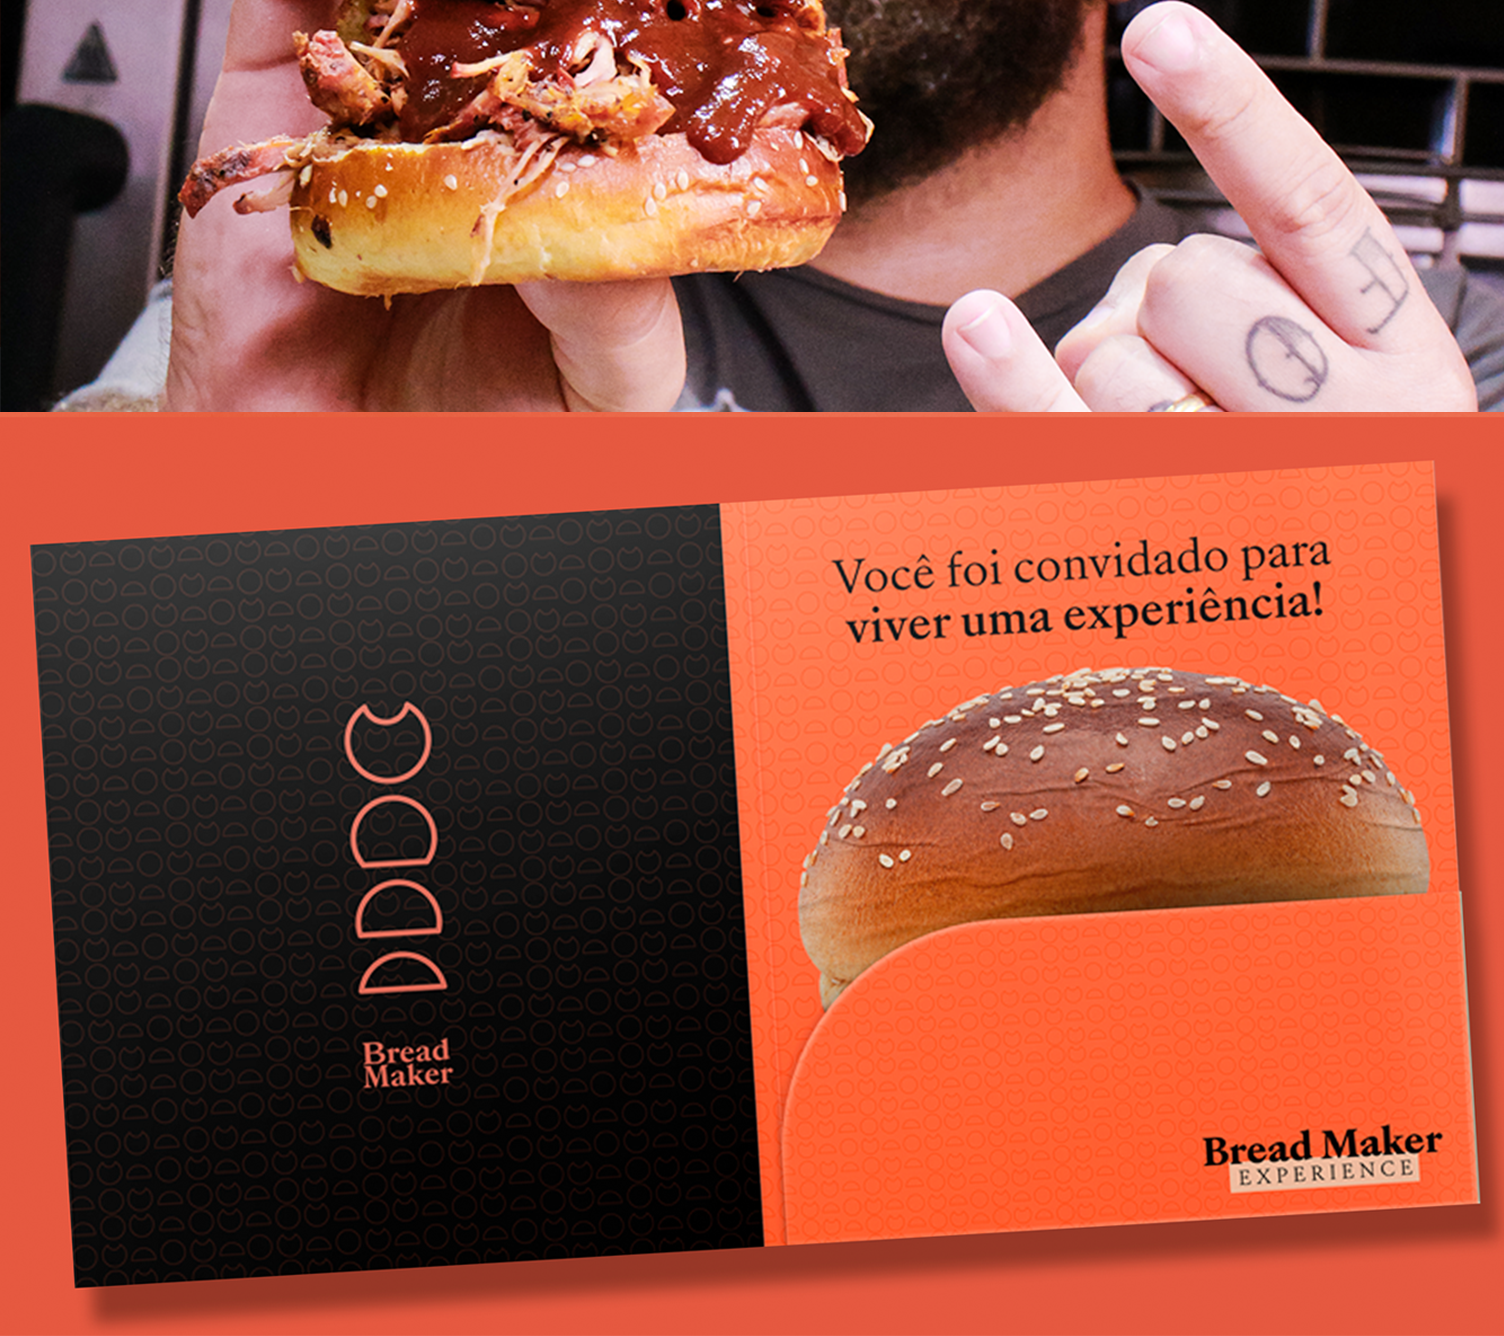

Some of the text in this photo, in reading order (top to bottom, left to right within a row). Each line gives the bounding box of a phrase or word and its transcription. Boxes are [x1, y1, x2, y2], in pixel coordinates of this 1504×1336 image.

[832, 536, 1332, 594] Você foi convidado para
[845, 580, 1324, 644] viver uma experiência!
[362, 1037, 451, 1066] Bread
[363, 1063, 454, 1089] Maker
[1201, 1123, 1445, 1167] Bread Maker
[1238, 1159, 1415, 1186] EXPERIENCE
